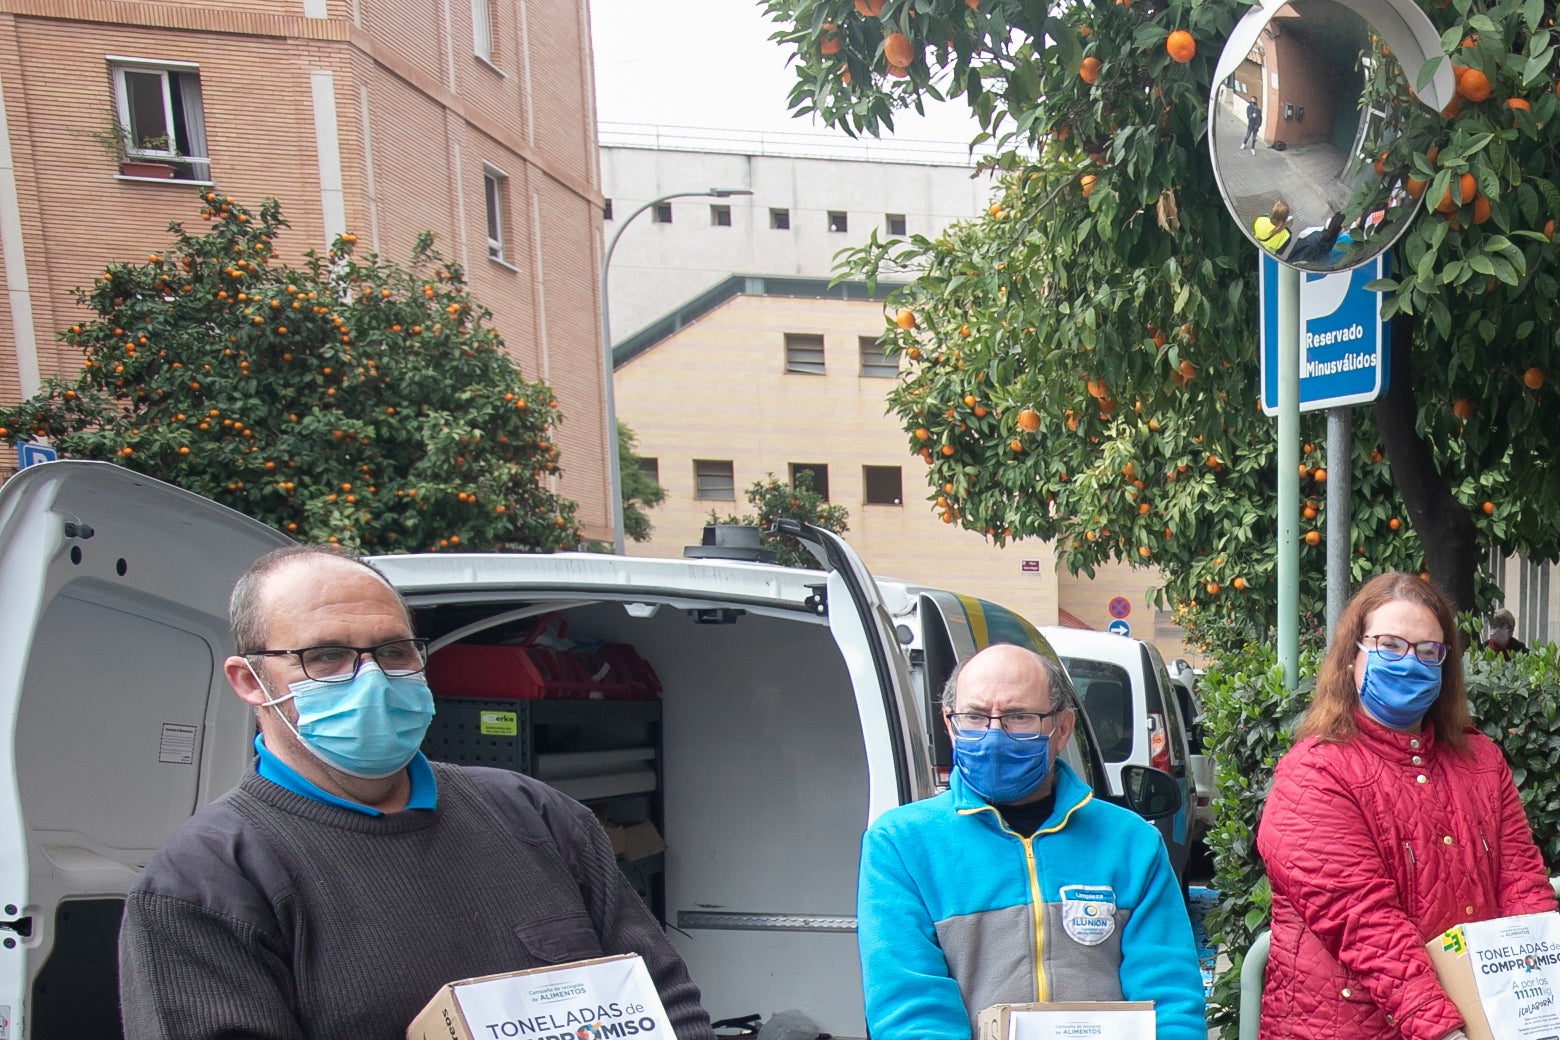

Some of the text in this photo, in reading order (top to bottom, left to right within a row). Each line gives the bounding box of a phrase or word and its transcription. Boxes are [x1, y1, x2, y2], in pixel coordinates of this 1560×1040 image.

[1306, 323, 1363, 349] Reservado
[1306, 352, 1377, 378] Minusválidos
[1073, 919, 1108, 927] ILUNION
[1477, 942, 1548, 961] TONELADAS
[1550, 942, 1560, 951] de
[540, 987, 586, 1001] ALIMENTOS
[486, 1003, 645, 1040] TONELADAS de
